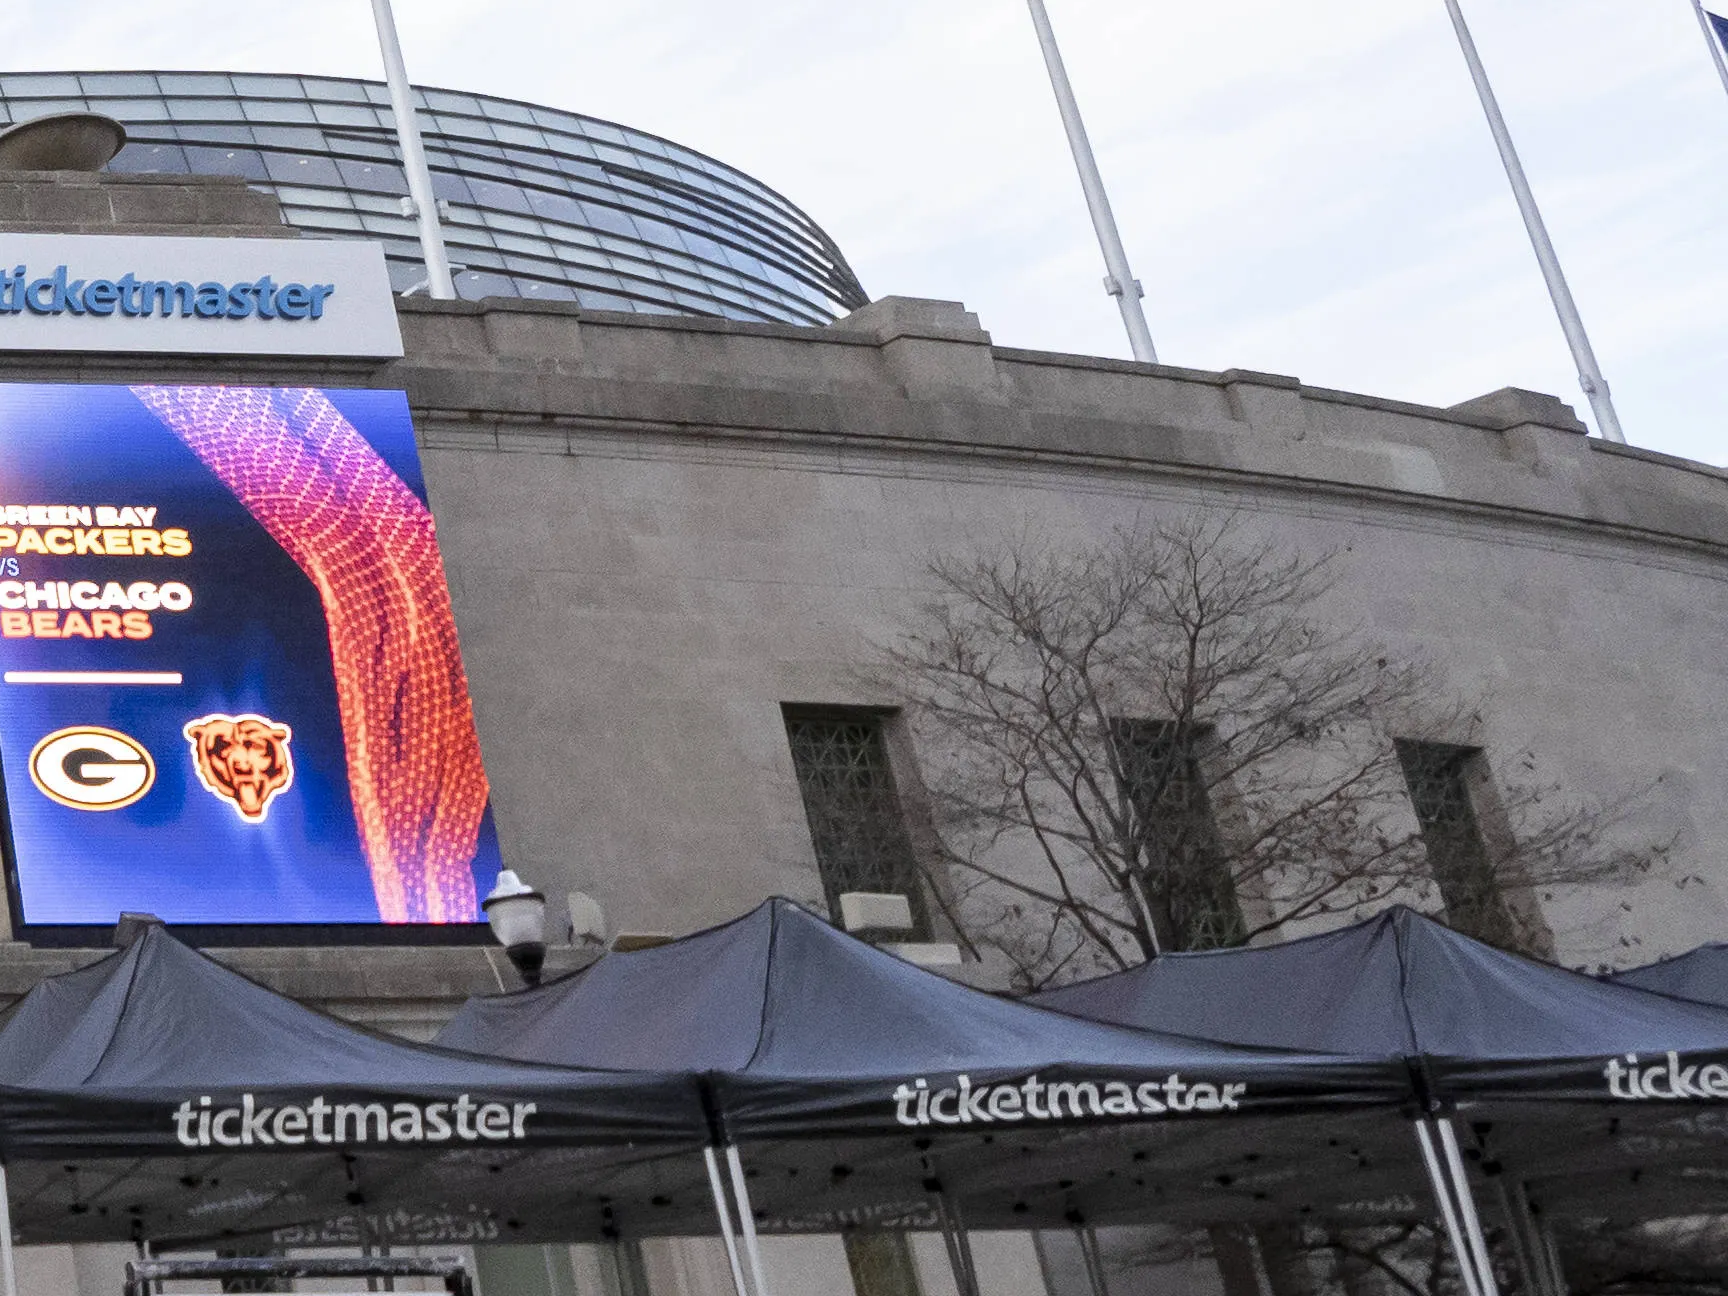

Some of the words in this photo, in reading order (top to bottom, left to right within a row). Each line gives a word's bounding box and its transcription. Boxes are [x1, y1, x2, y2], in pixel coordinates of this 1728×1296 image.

[96, 505, 157, 528] BAY
[1, 612, 153, 639] BEARS
[34, 731, 150, 805] G
[173, 1094, 537, 1147] ticketmaster
